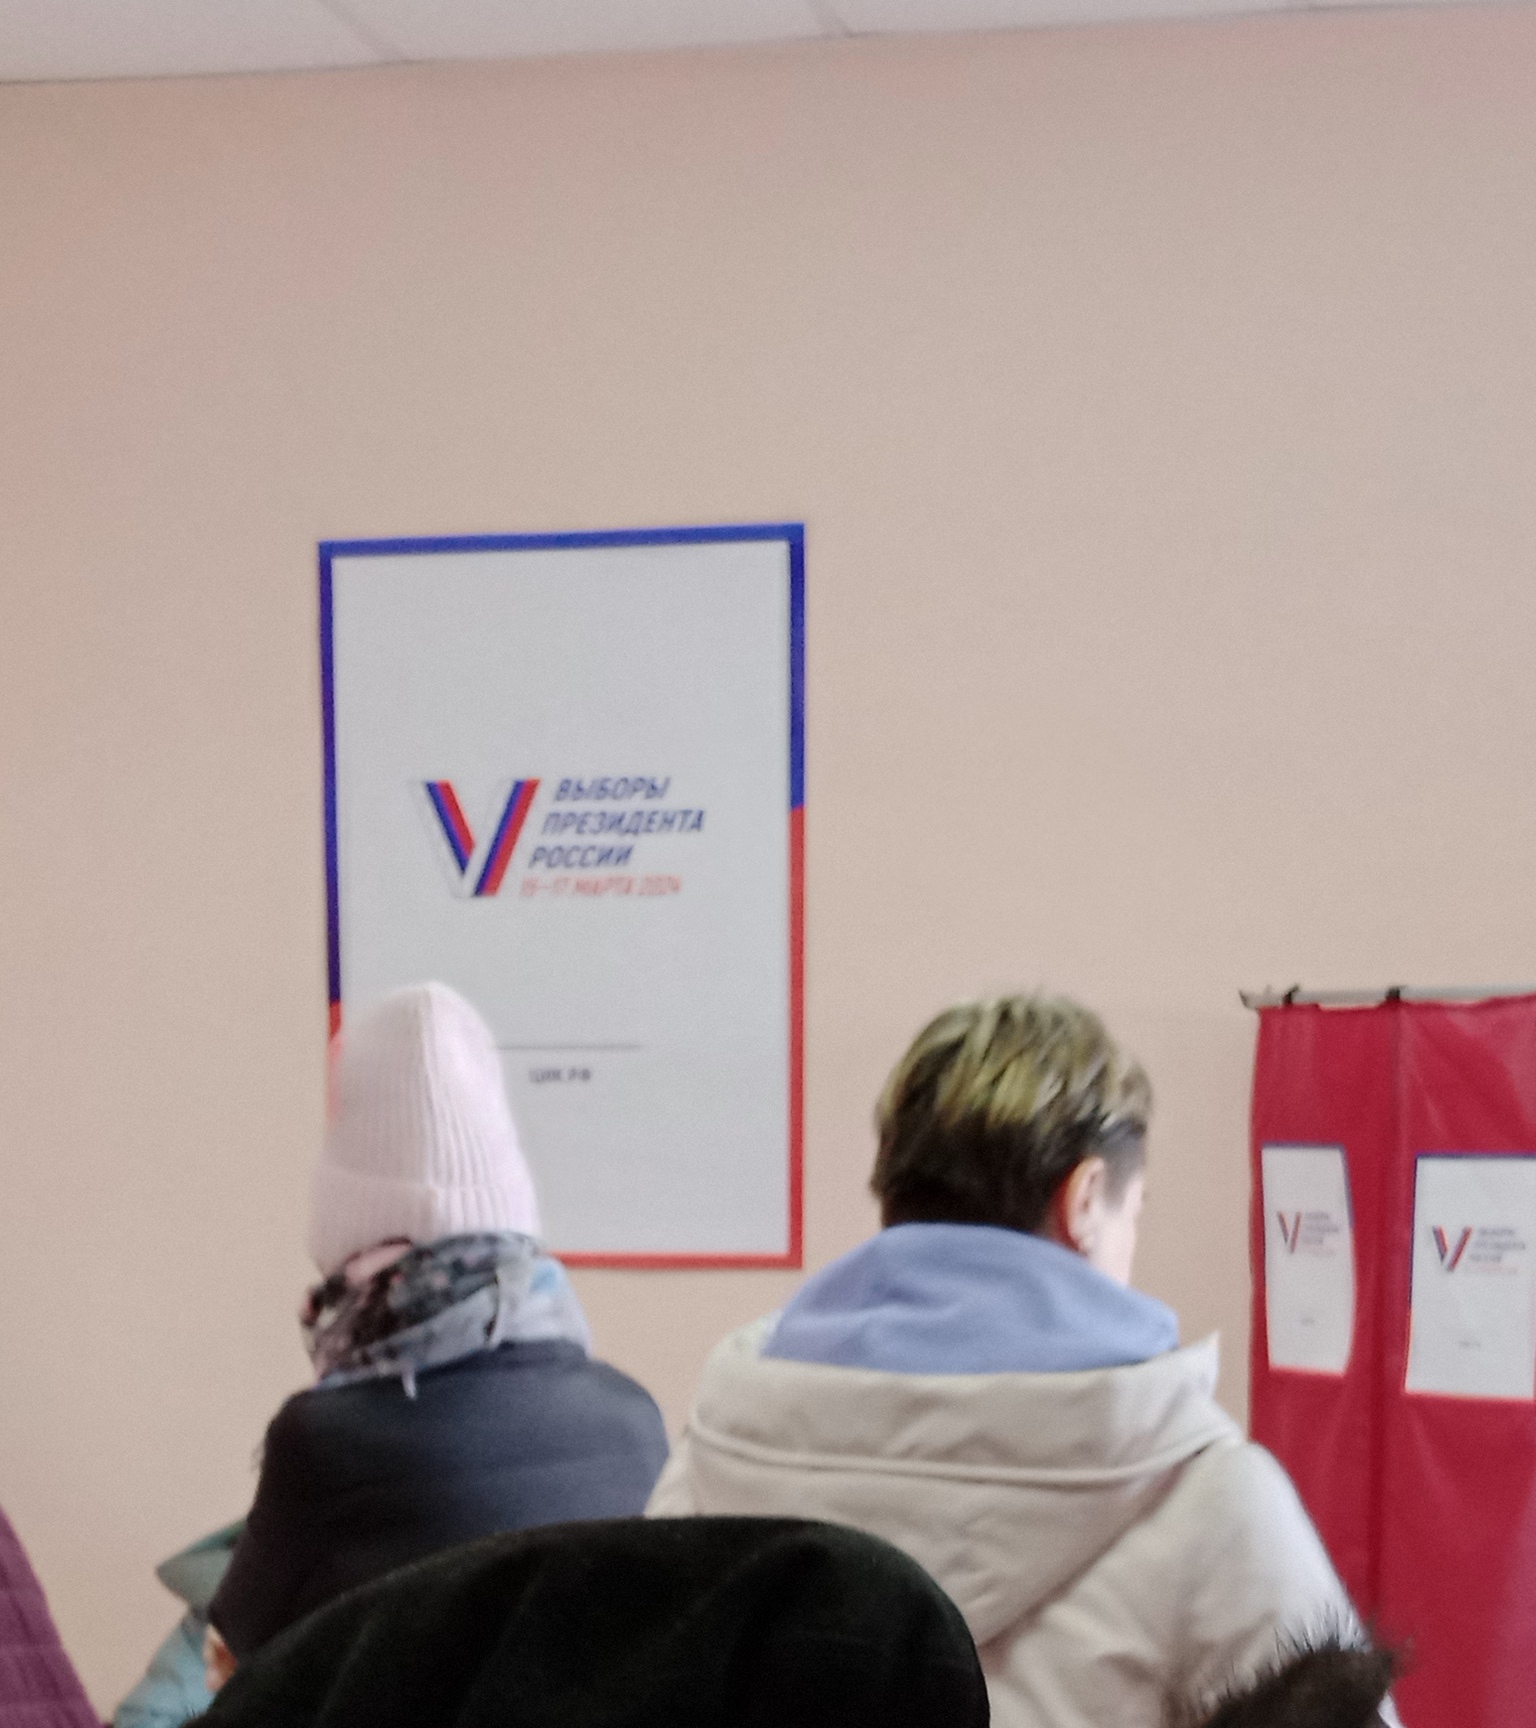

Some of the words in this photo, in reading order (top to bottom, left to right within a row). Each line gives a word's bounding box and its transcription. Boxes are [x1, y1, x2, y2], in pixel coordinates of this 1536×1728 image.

[555, 776, 671, 802] ВЫБОРЫ
[540, 808, 705, 837] ПРЕЗИДЕНТА
[527, 844, 635, 869] РОССИИ
